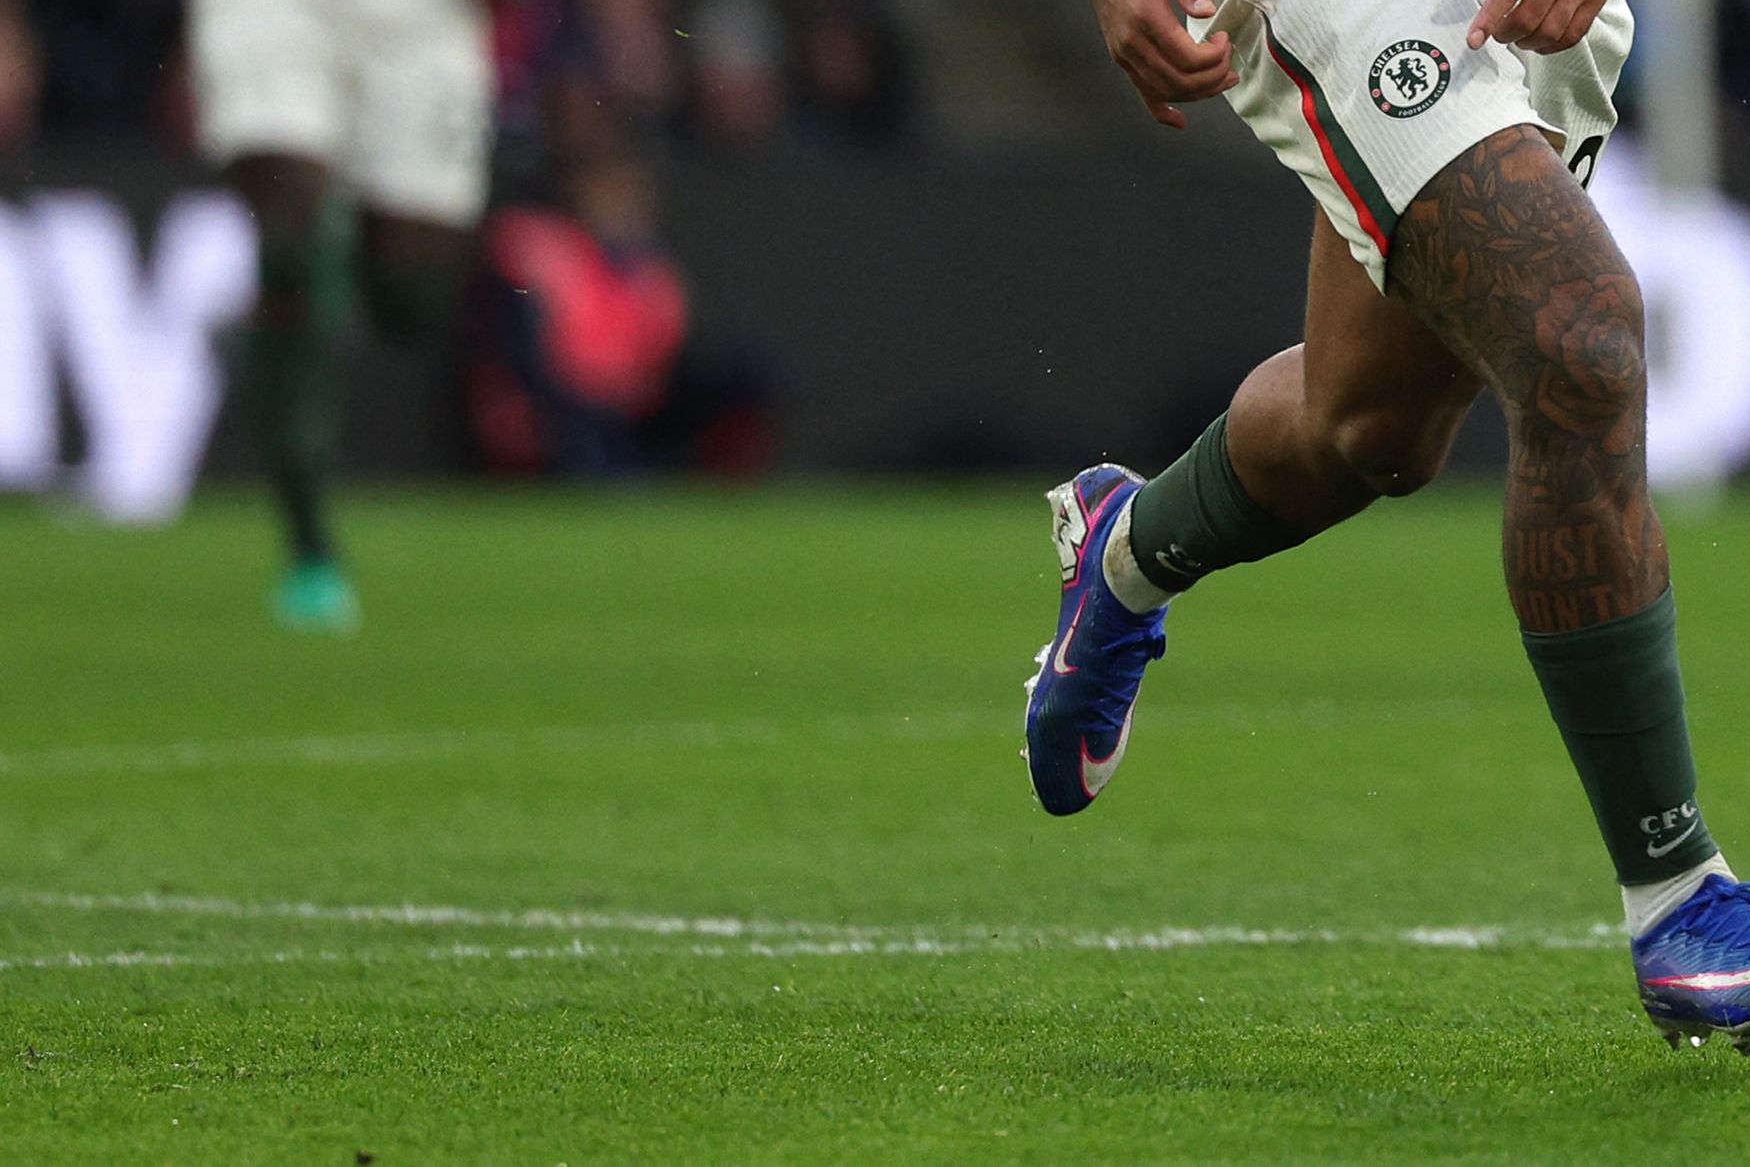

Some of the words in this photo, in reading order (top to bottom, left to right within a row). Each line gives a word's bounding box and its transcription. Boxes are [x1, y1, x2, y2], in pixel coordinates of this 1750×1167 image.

[1371, 41, 1420, 77] CHELSEA
[1398, 99, 1434, 116] FOOTBALL
[1640, 799, 1697, 834] CFC
